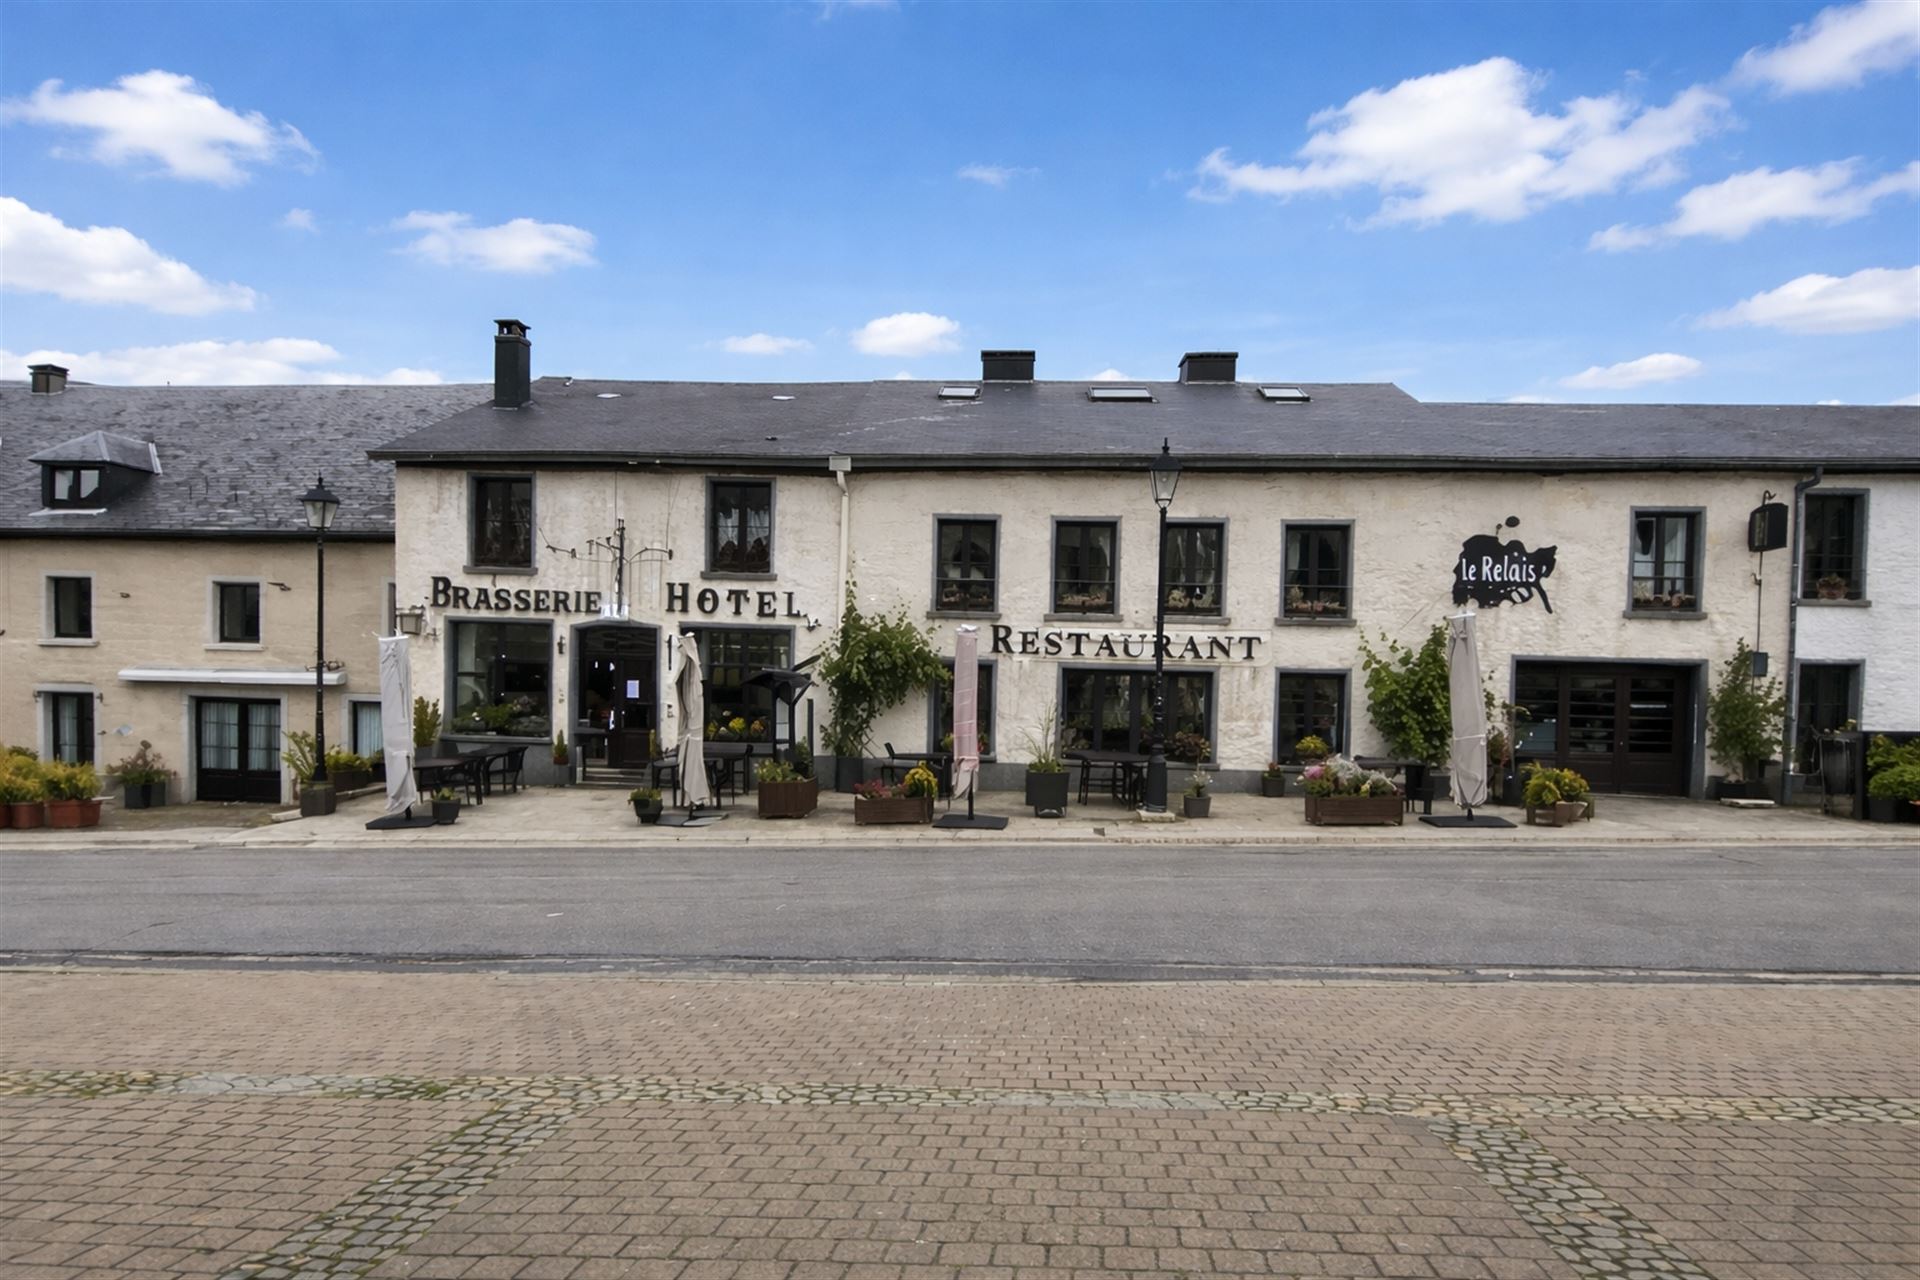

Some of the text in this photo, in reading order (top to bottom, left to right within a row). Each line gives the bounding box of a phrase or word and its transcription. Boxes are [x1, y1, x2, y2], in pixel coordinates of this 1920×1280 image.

[1462, 555, 1536, 582] le Relais
[430, 576, 602, 613] BRASSERIE
[665, 582, 801, 618] HOTEL
[990, 624, 1262, 660] RESTAURANT
